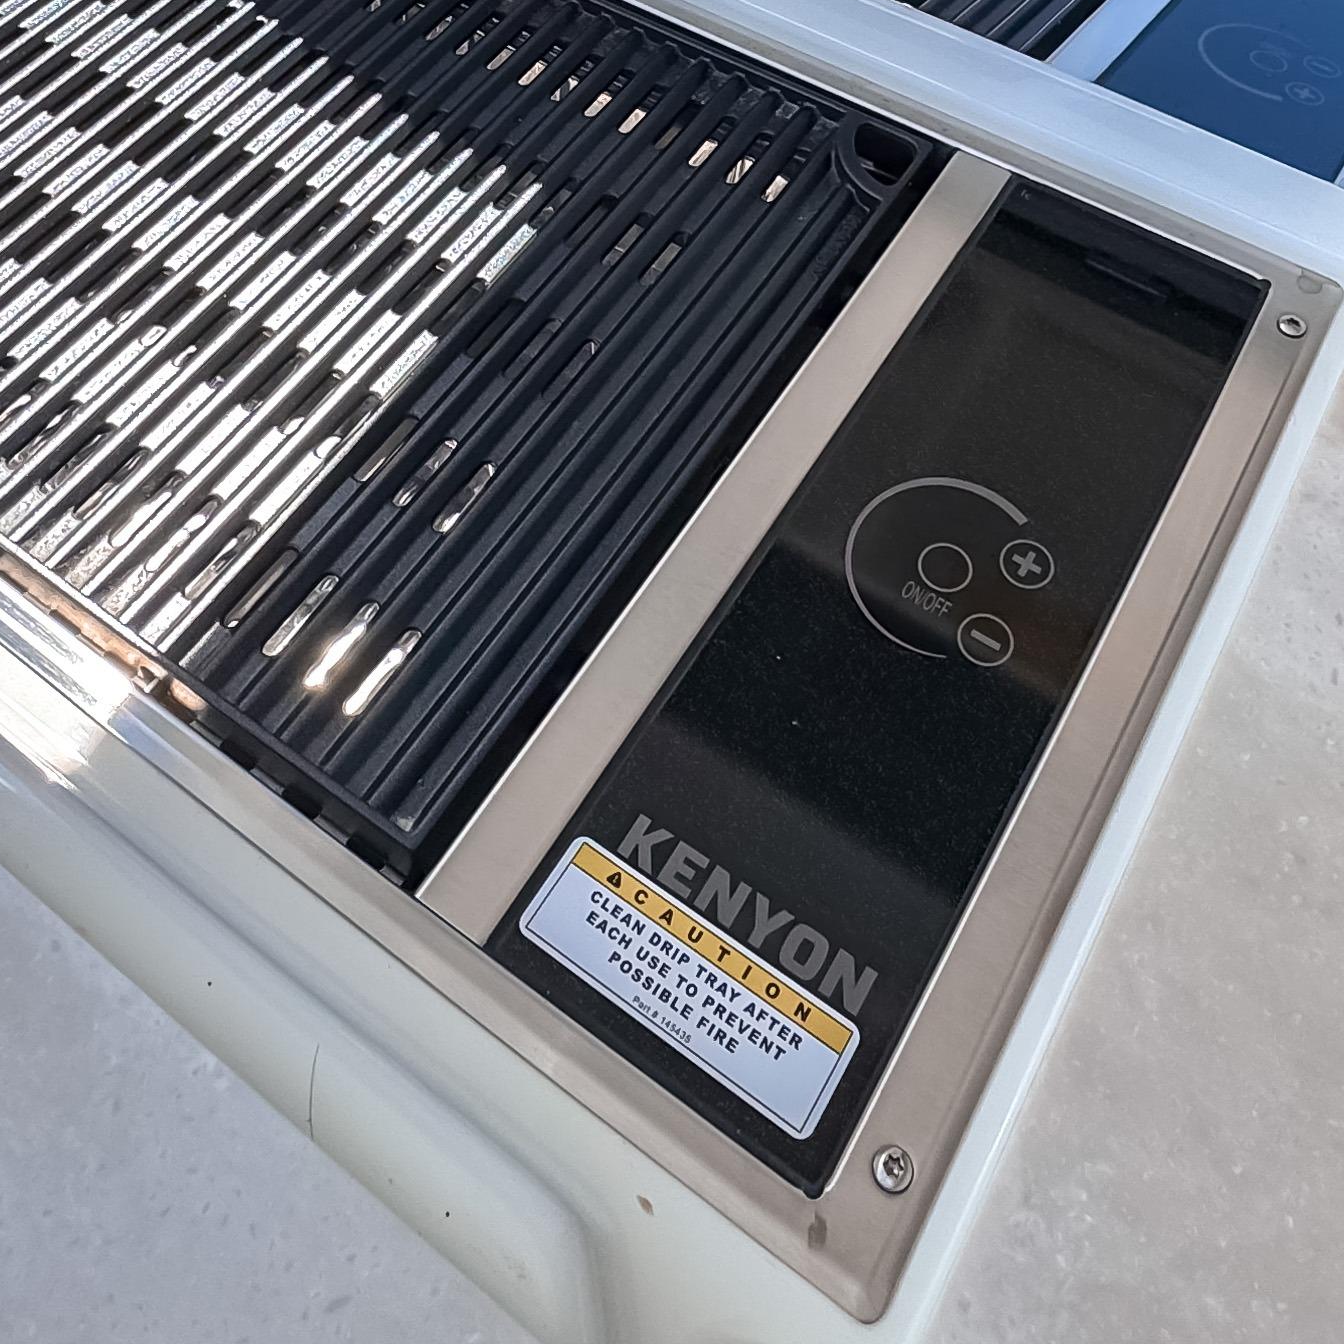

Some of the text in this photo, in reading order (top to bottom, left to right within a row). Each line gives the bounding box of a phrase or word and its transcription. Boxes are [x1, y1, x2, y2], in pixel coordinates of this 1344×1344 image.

[901, 581, 953, 617] ON/OFF
[590, 891, 803, 1051] CLEAN DRIP TRAY AFTER
[617, 814, 879, 1016] KENYON
[634, 889, 812, 1023] CAUTION
[585, 910, 787, 1061] EACH USE TO PREVENT
[607, 951, 739, 1054] POSSIBLE FIRE
[632, 995, 651, 1014] Part
